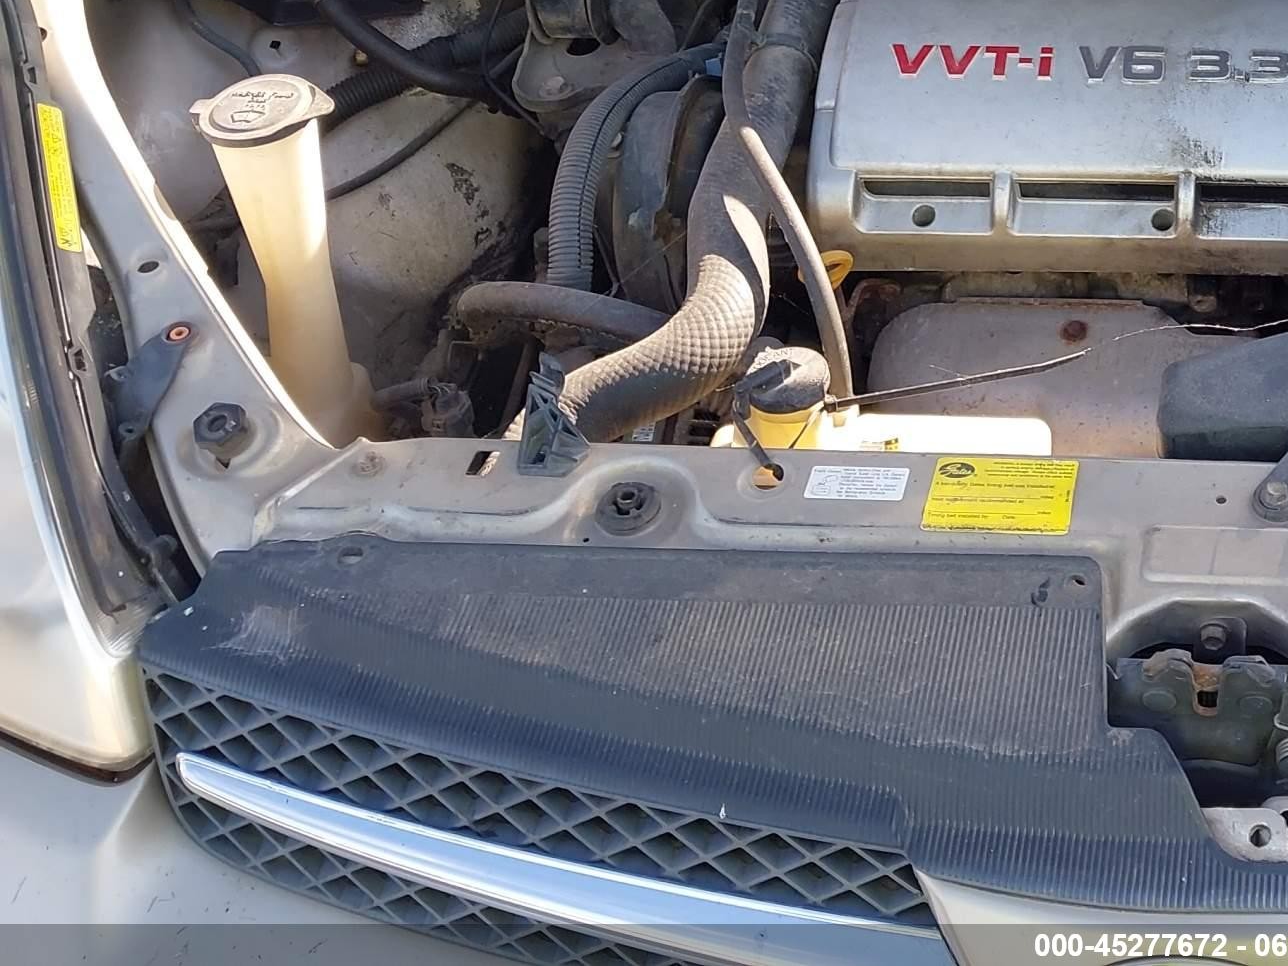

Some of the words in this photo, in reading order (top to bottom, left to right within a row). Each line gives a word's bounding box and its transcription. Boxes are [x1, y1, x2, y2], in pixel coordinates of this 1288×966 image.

[891, 43, 1055, 81] VVT-i
[1079, 45, 1167, 84] V6
[939, 463, 973, 477] Gates
